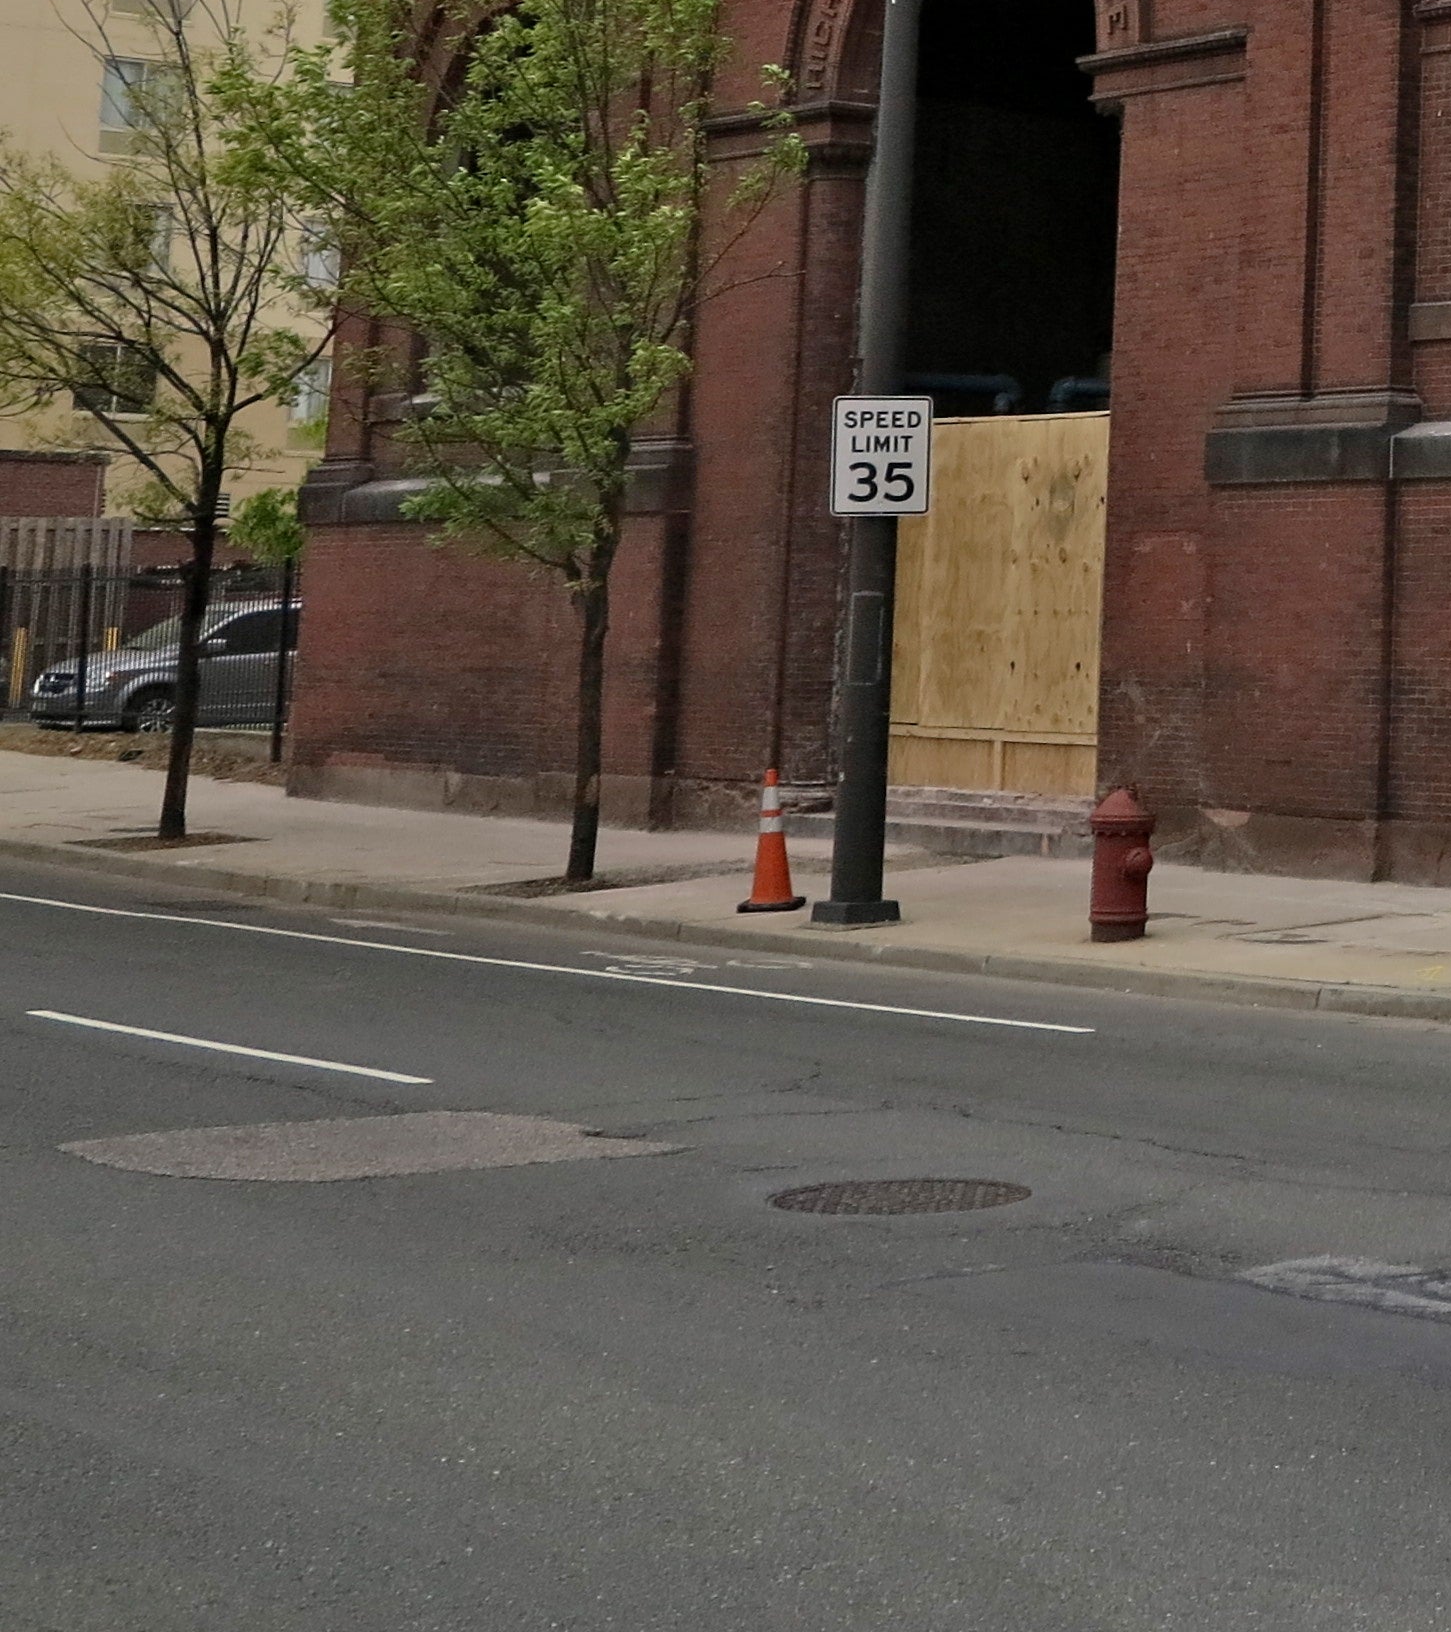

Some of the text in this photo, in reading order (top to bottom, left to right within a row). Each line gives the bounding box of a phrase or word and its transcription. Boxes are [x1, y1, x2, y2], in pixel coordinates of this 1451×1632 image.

[844, 411, 922, 429] SPEED
[851, 436, 913, 453] LIMIT
[848, 462, 914, 502] 35
